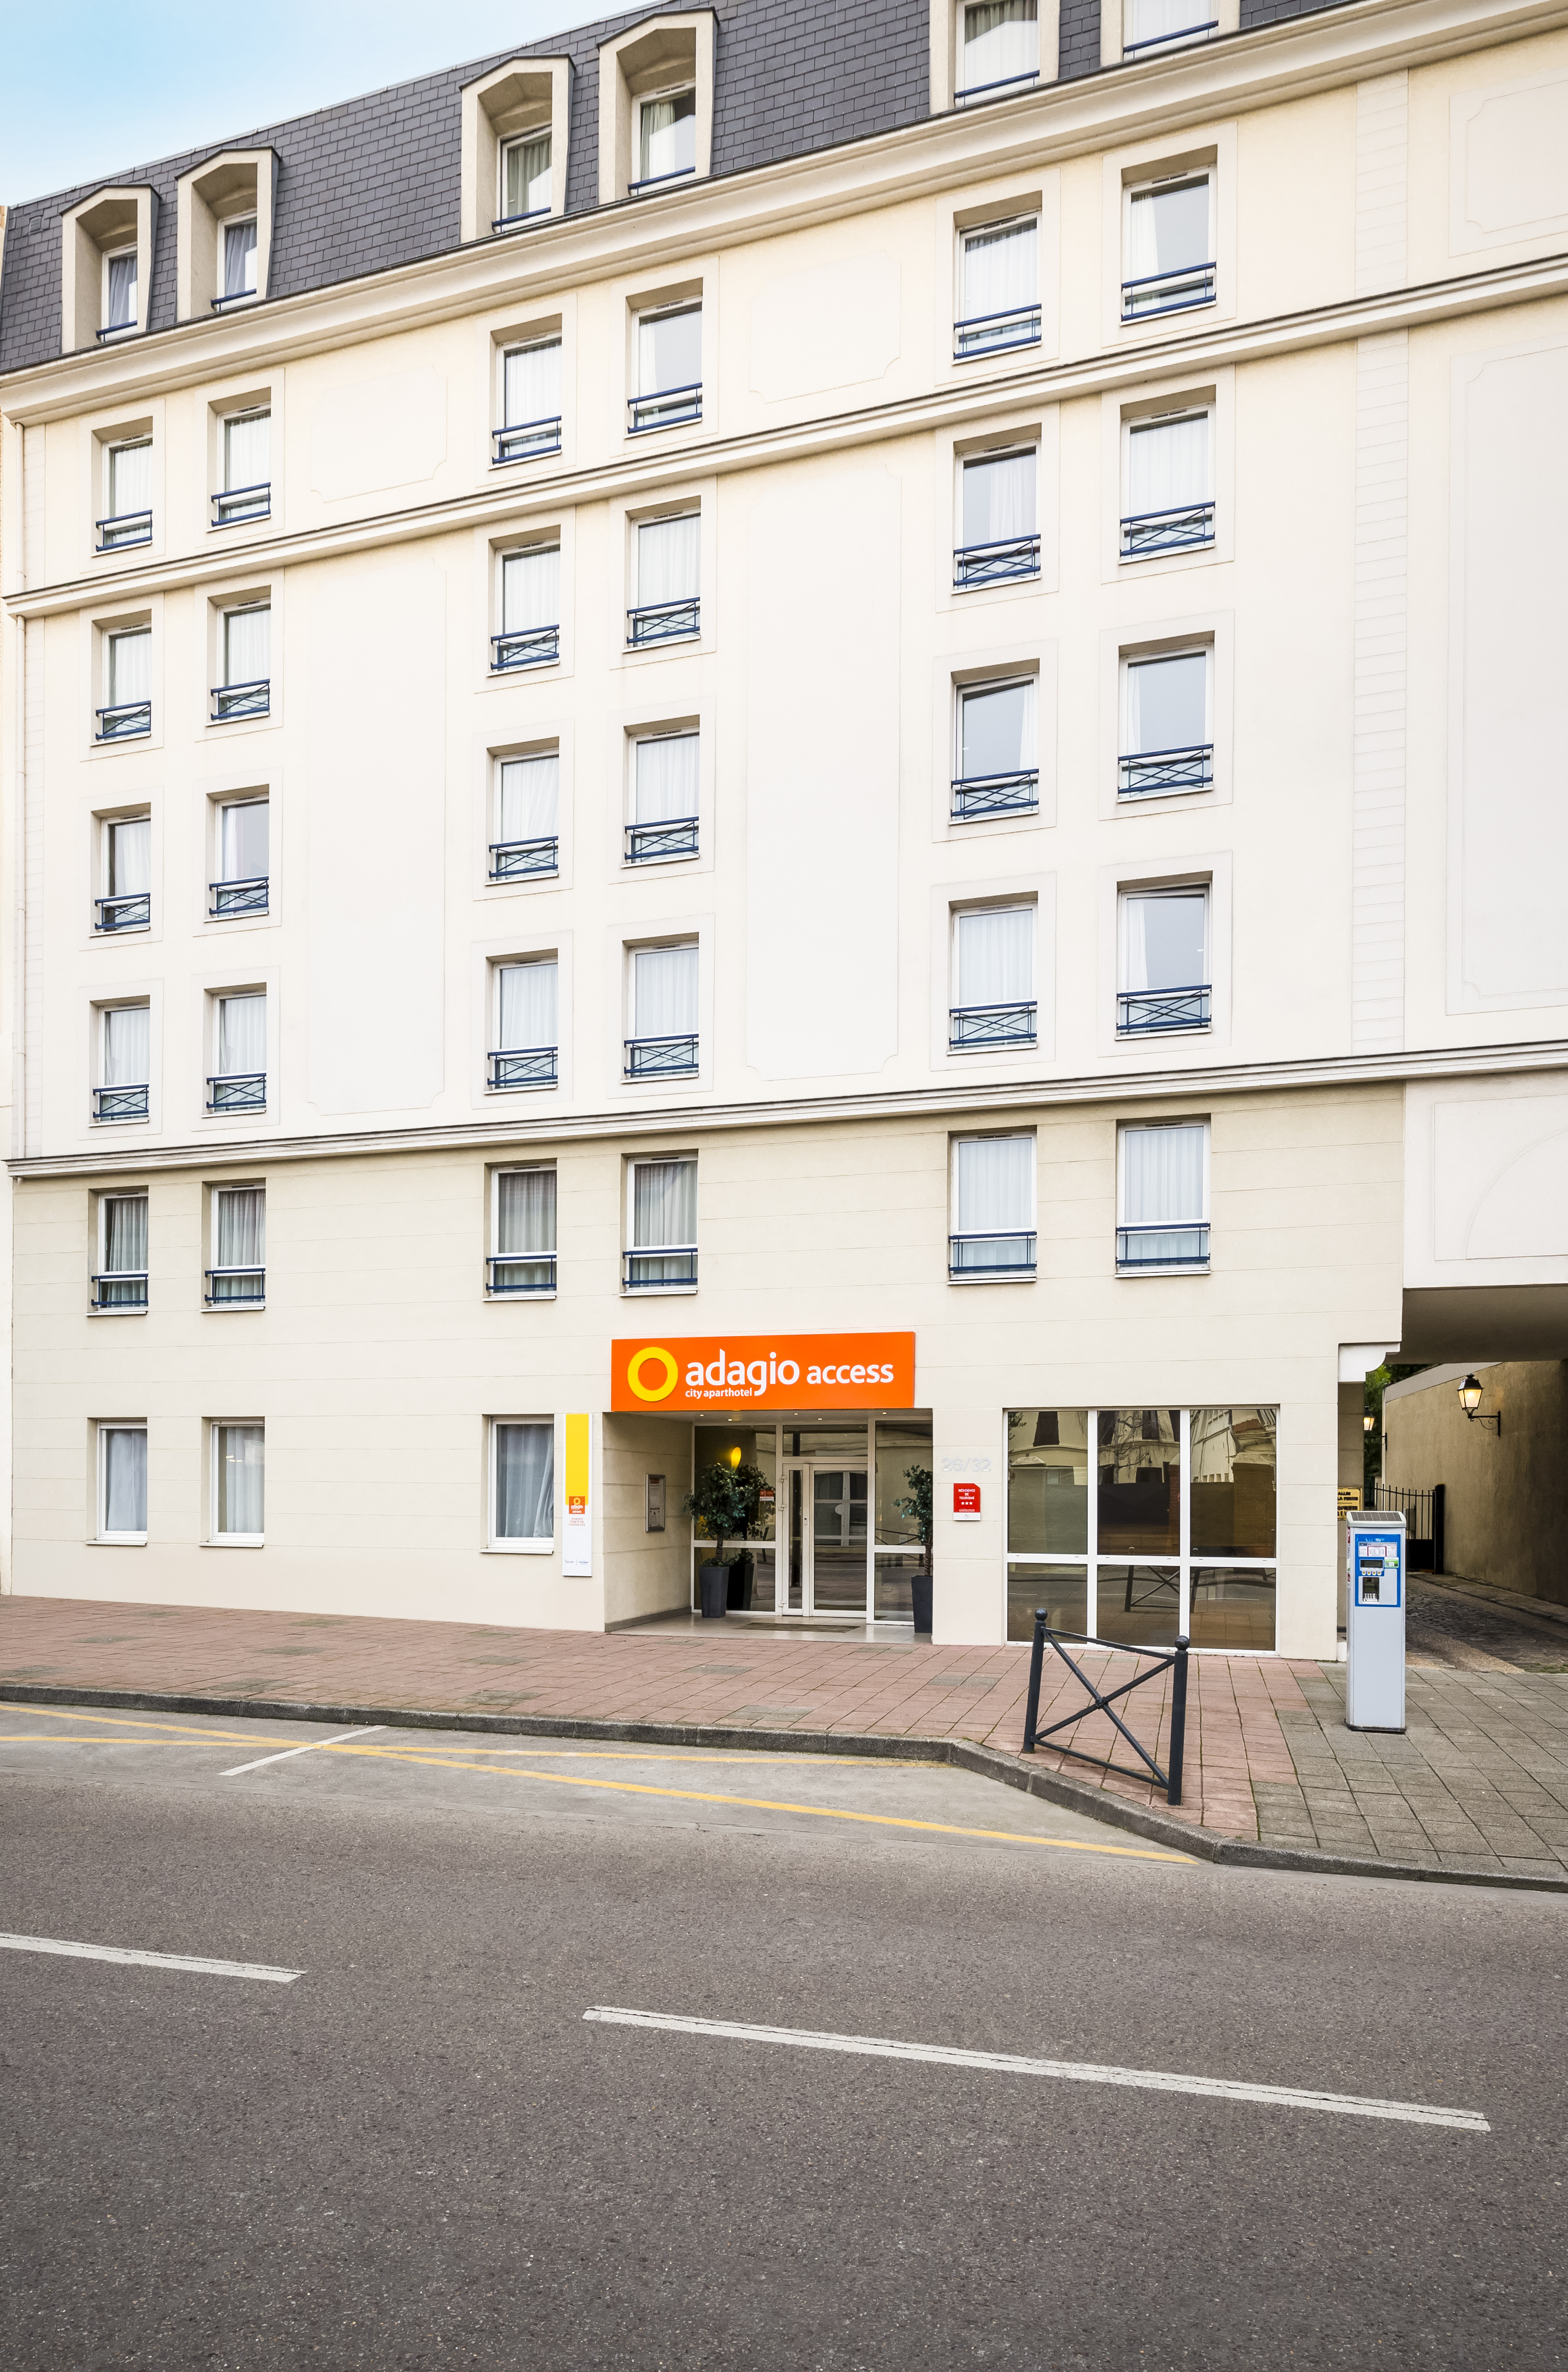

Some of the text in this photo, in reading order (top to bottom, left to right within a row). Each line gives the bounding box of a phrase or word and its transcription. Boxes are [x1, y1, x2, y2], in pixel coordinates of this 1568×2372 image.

[685, 1349, 894, 1396] adagio access
[685, 1388, 752, 1399] city aparthotel
[942, 1458, 991, 1472] 26/32
